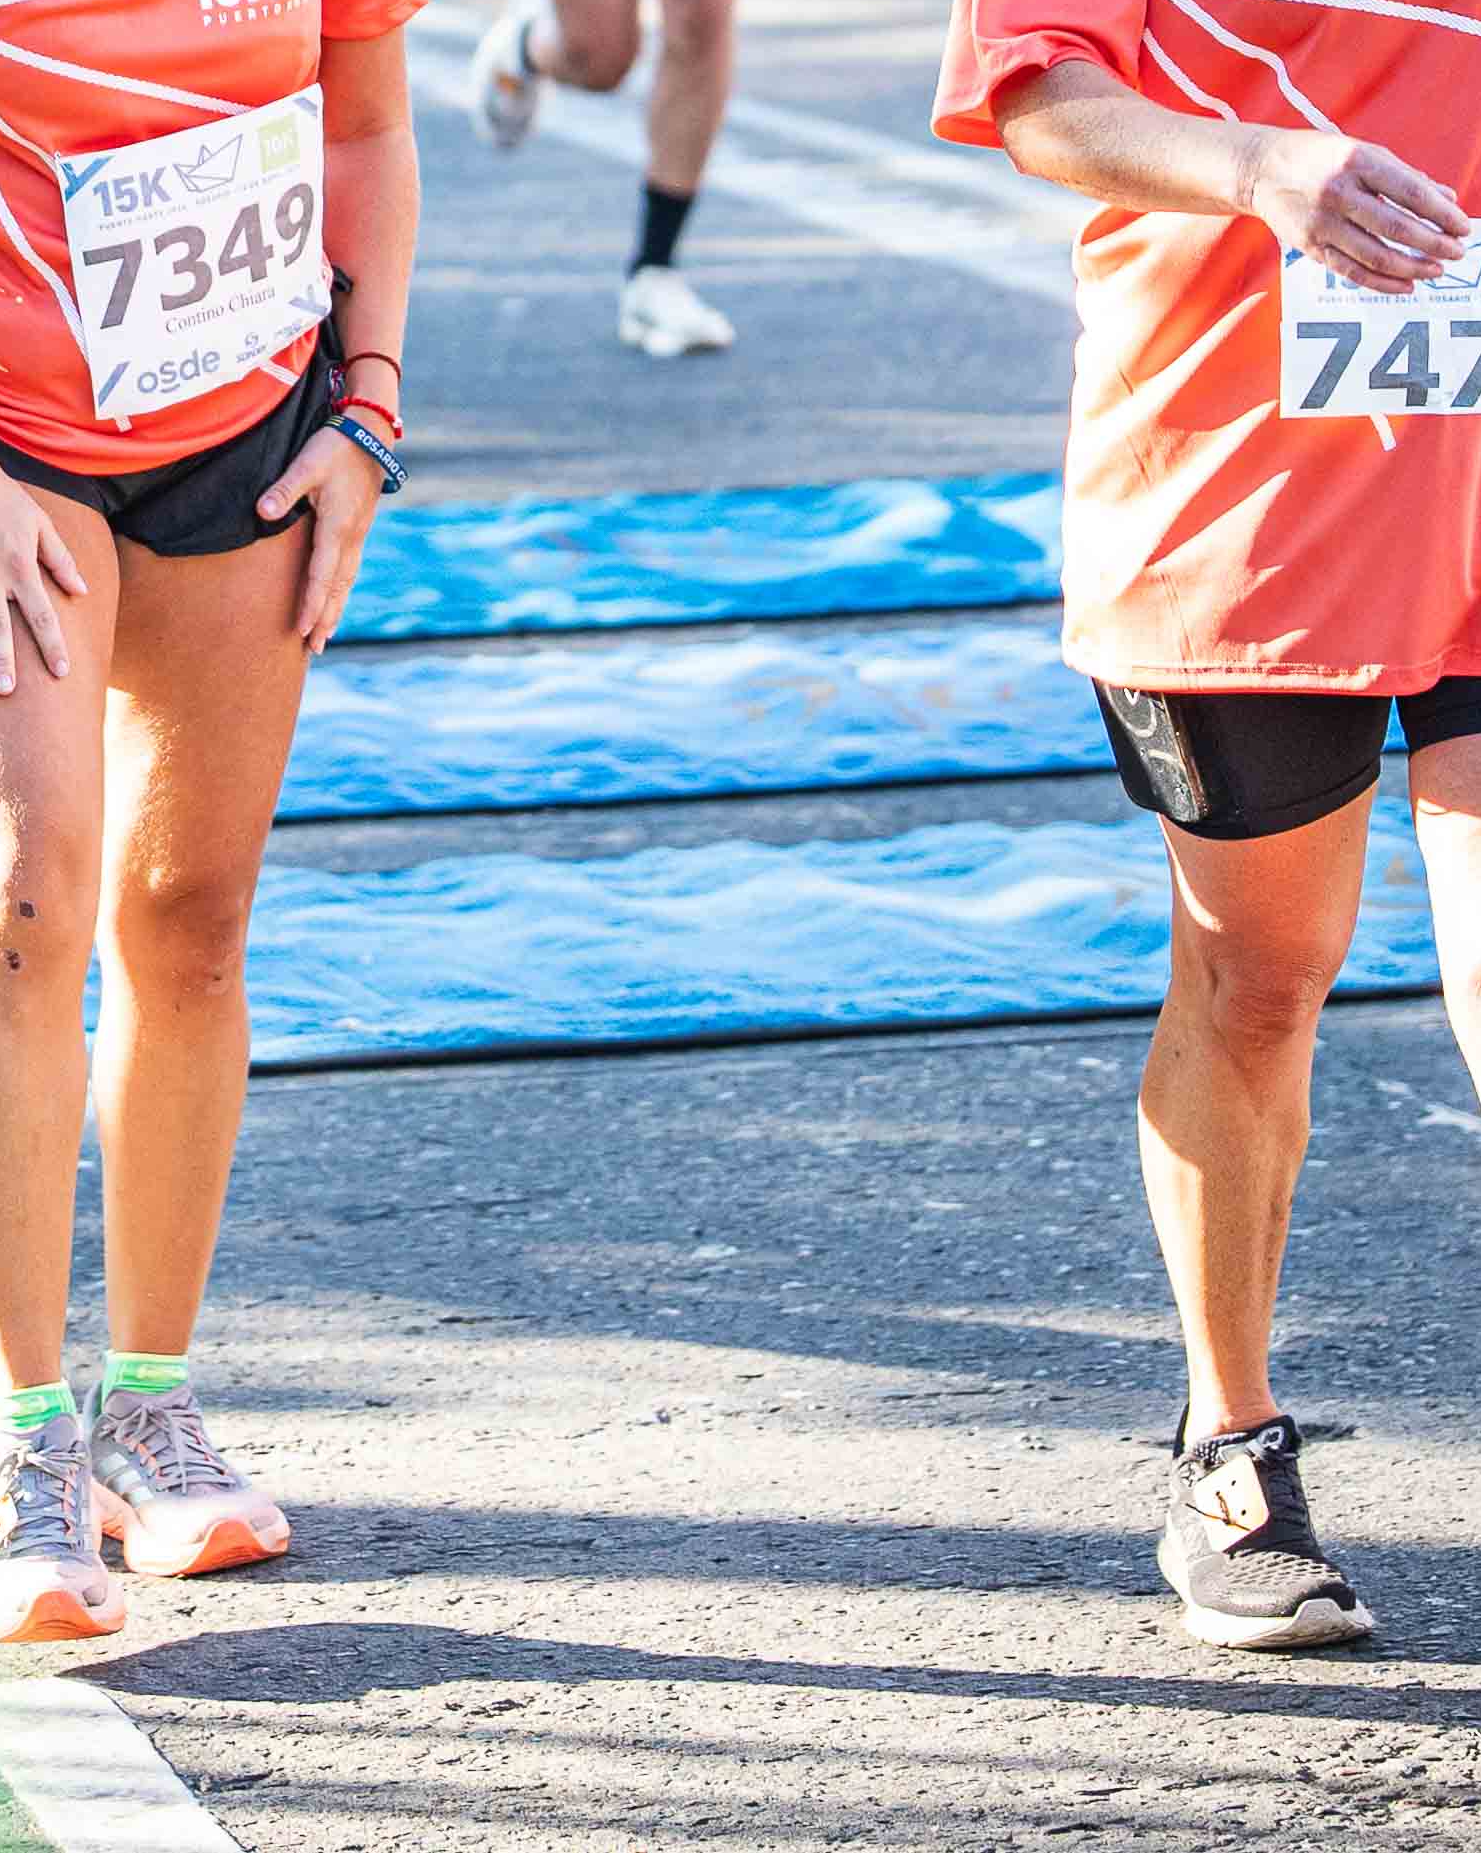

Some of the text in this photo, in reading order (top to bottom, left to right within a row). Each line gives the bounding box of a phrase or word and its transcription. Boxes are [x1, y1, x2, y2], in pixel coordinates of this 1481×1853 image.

[92, 166, 172, 217] 15K
[82, 182, 315, 330] 7349
[137, 348, 221, 394] osde
[354, 429, 401, 477] ROSARIO
